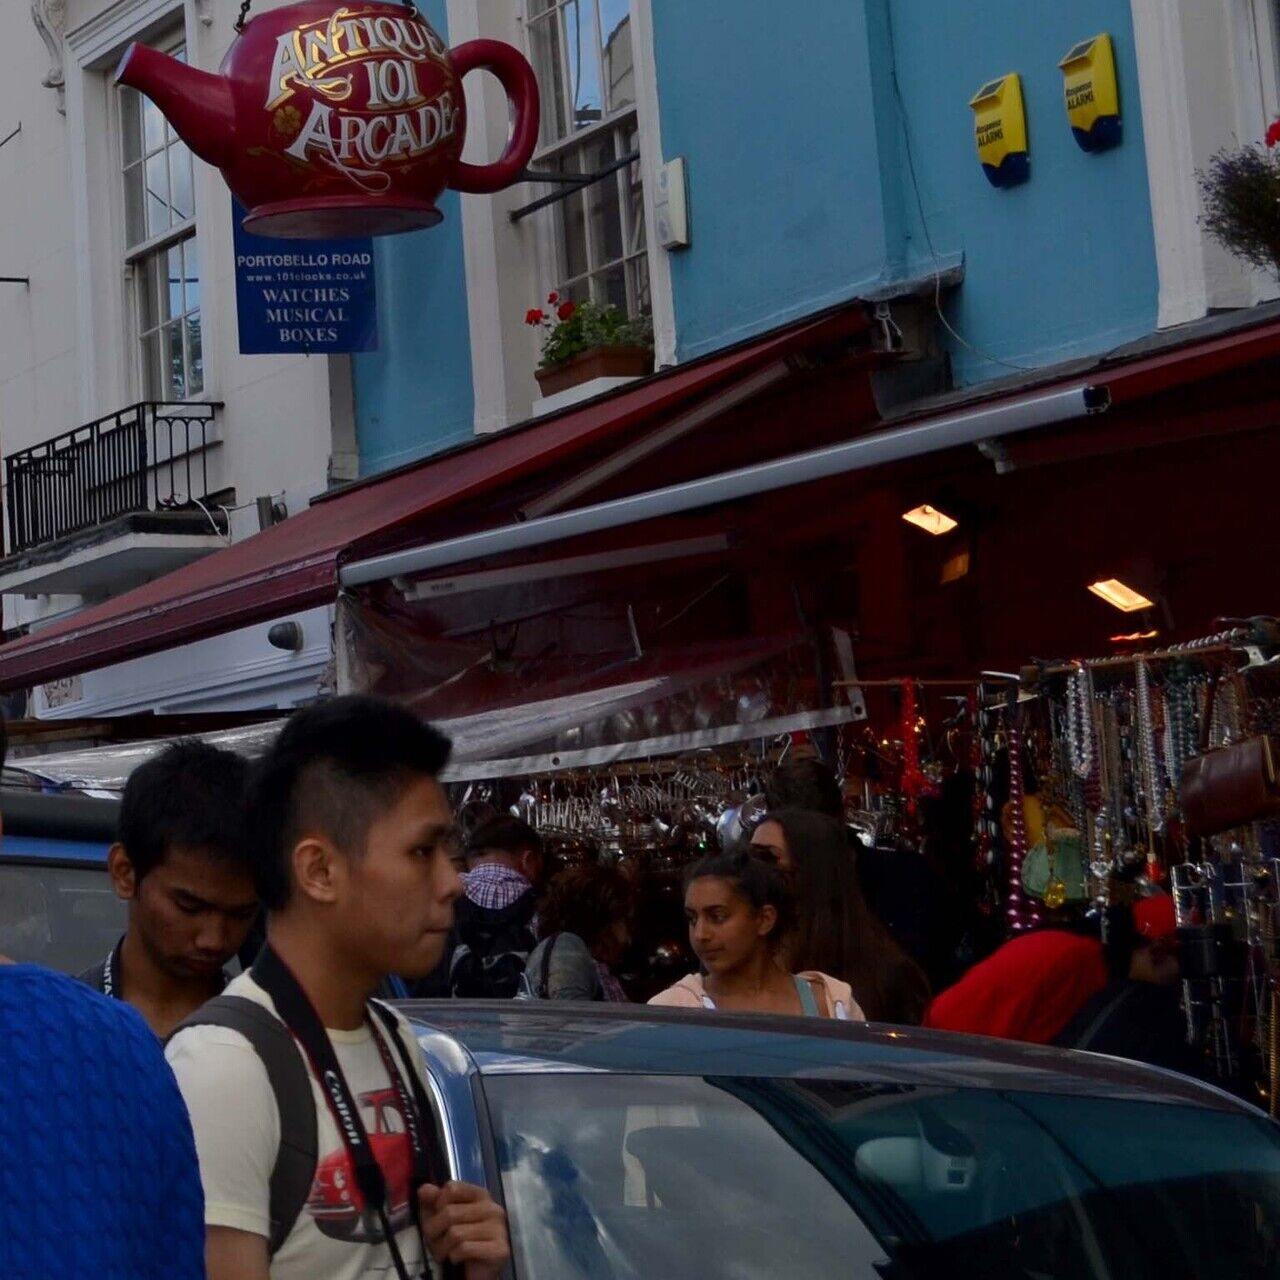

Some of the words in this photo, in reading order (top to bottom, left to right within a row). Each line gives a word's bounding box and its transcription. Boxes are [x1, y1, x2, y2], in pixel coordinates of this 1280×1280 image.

[362, 59, 424, 110] 101
[1068, 91, 1095, 110] ALARMS
[284, 91, 459, 195] ARCADE
[978, 128, 1004, 147] ALARMS
[238, 254, 328, 267] PORTOBELLO
[331, 253, 372, 265] ROAD
[246, 271, 367, 282] www.101clocks.co.uk
[263, 288, 350, 303] WATCHES
[267, 308, 348, 322] MUSICAL
[280, 328, 338, 343] BOXES
[324, 1070, 361, 1146] Canon
